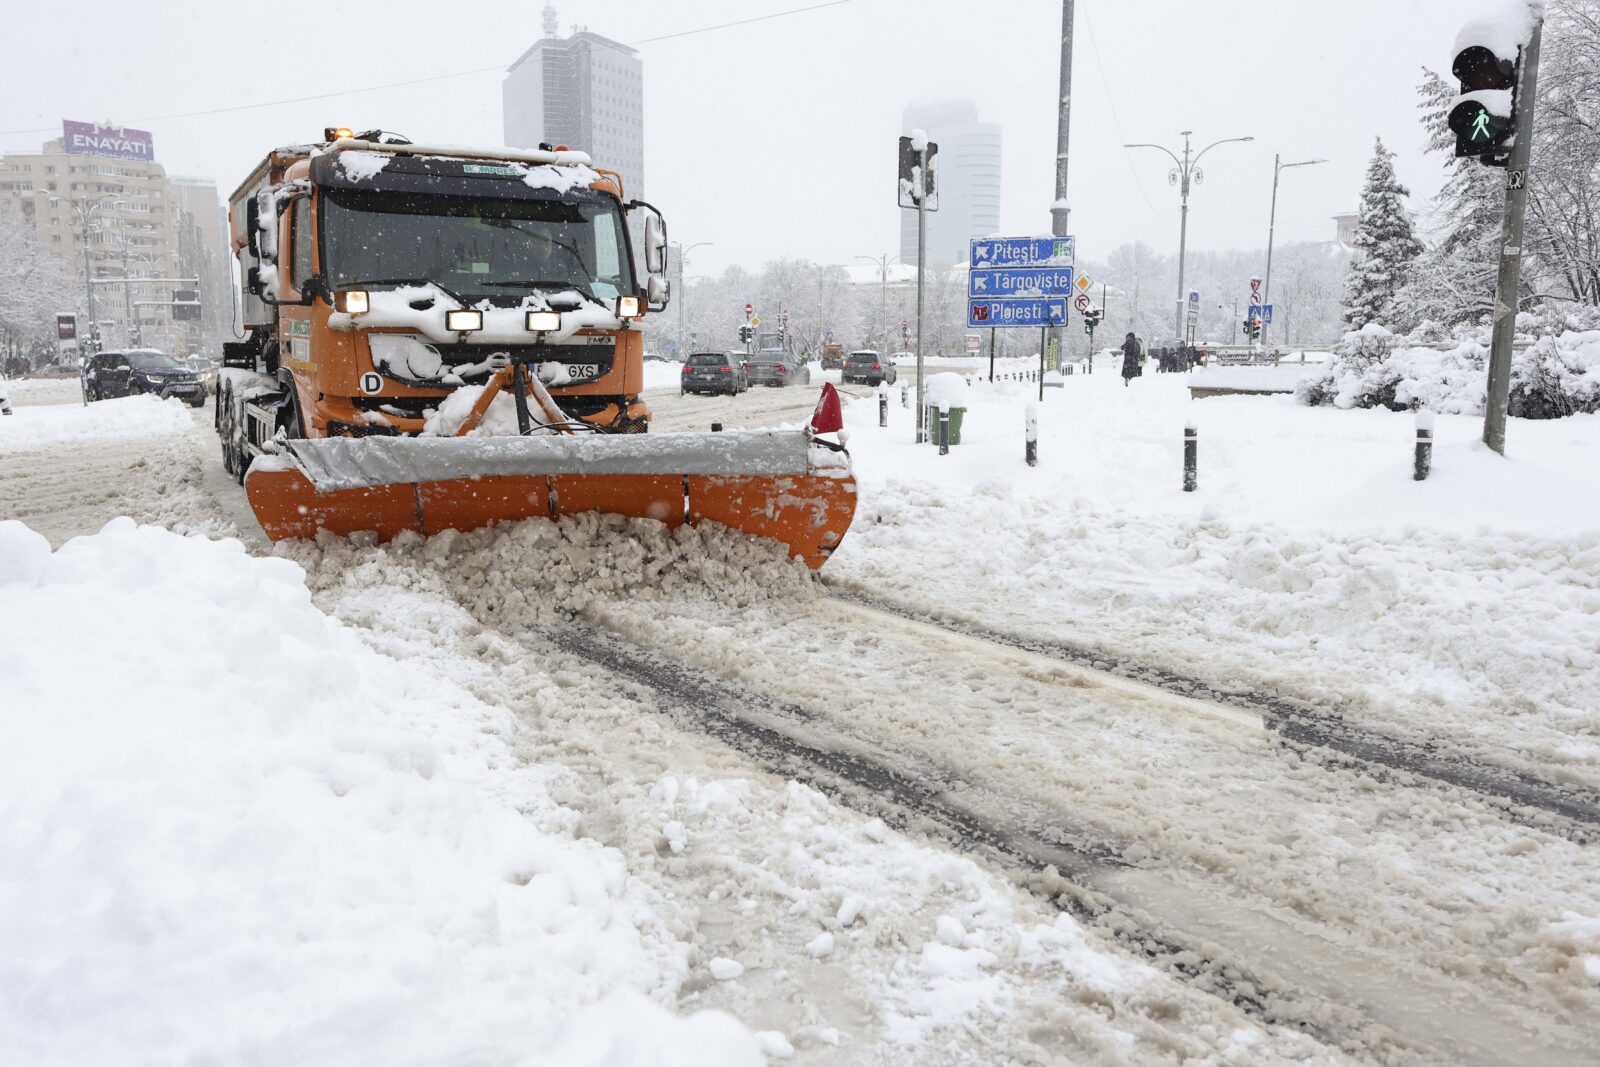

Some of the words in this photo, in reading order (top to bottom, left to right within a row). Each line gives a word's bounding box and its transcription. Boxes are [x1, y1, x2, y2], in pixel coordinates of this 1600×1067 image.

[73, 134, 147, 154] ENAYATI
[464, 165, 519, 175] ROMPRES
[568, 365, 594, 378] GXS
[365, 375, 380, 392] D
